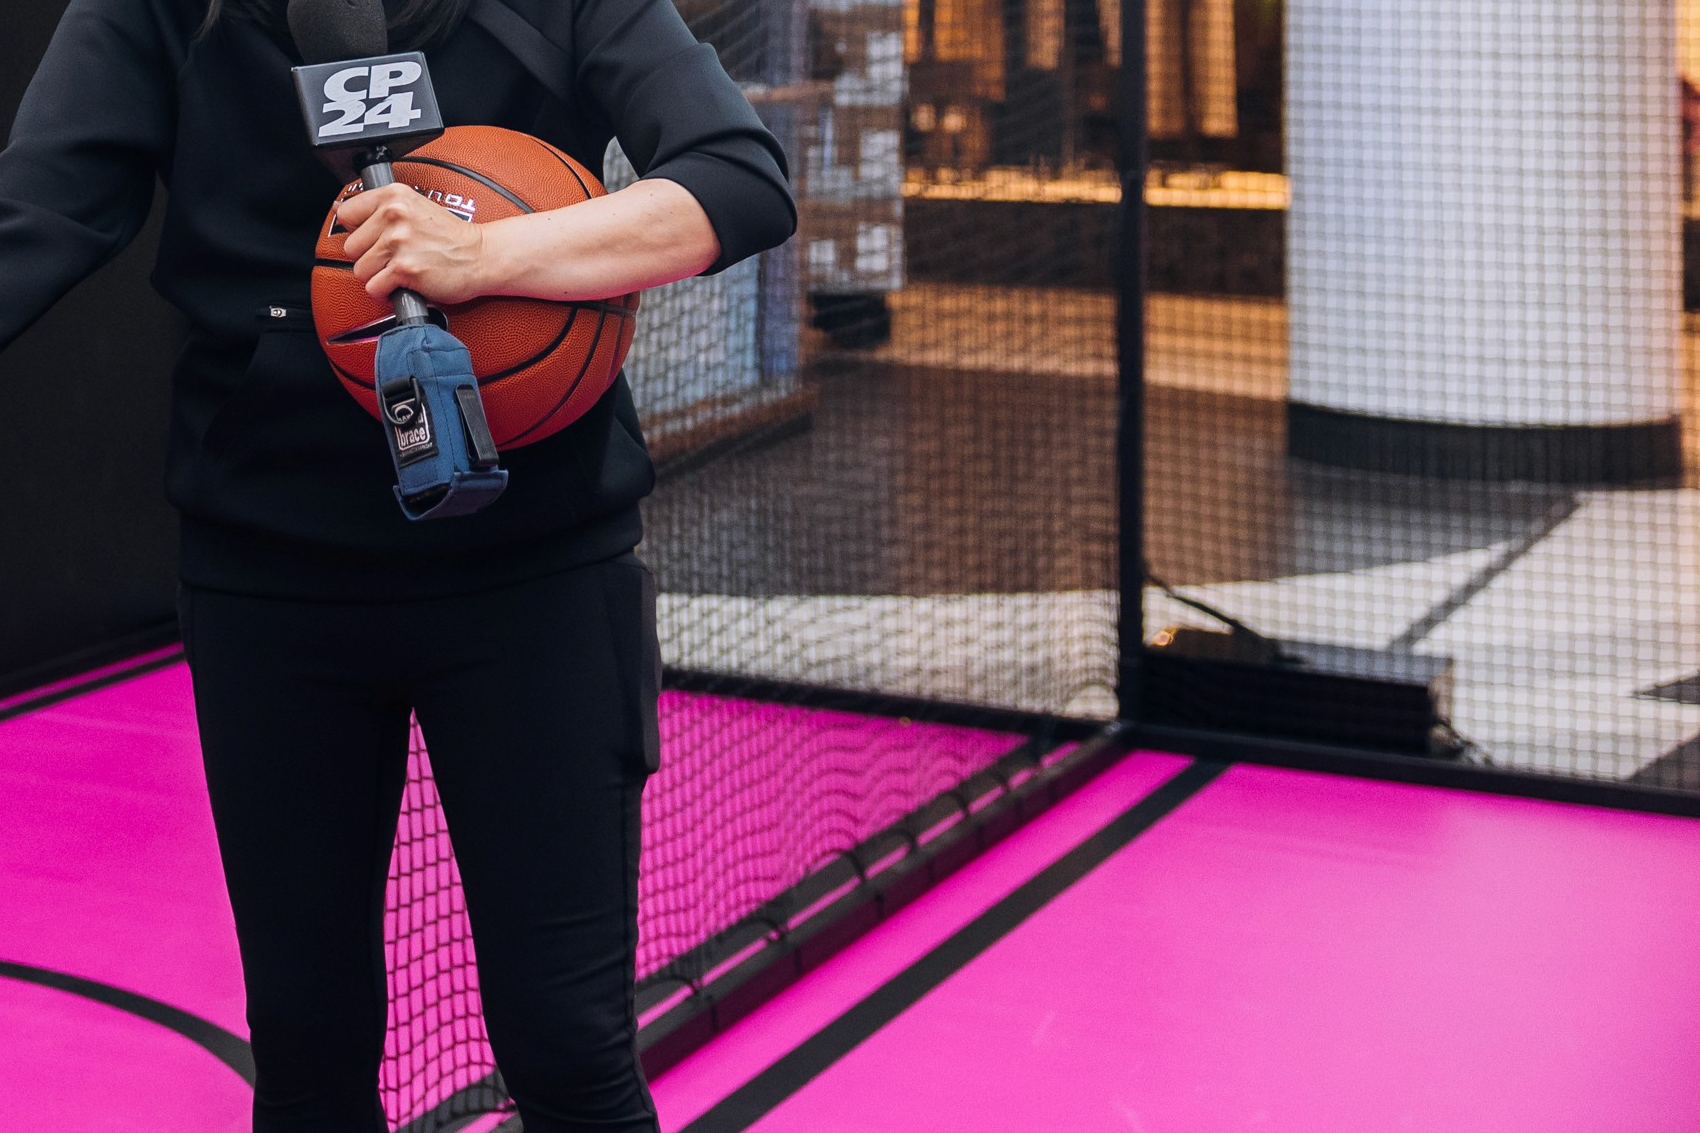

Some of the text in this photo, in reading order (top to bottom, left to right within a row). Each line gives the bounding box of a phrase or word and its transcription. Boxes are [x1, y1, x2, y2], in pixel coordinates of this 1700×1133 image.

[323, 61, 422, 102] CP
[318, 91, 422, 137] 24
[399, 426, 427, 447] brace
